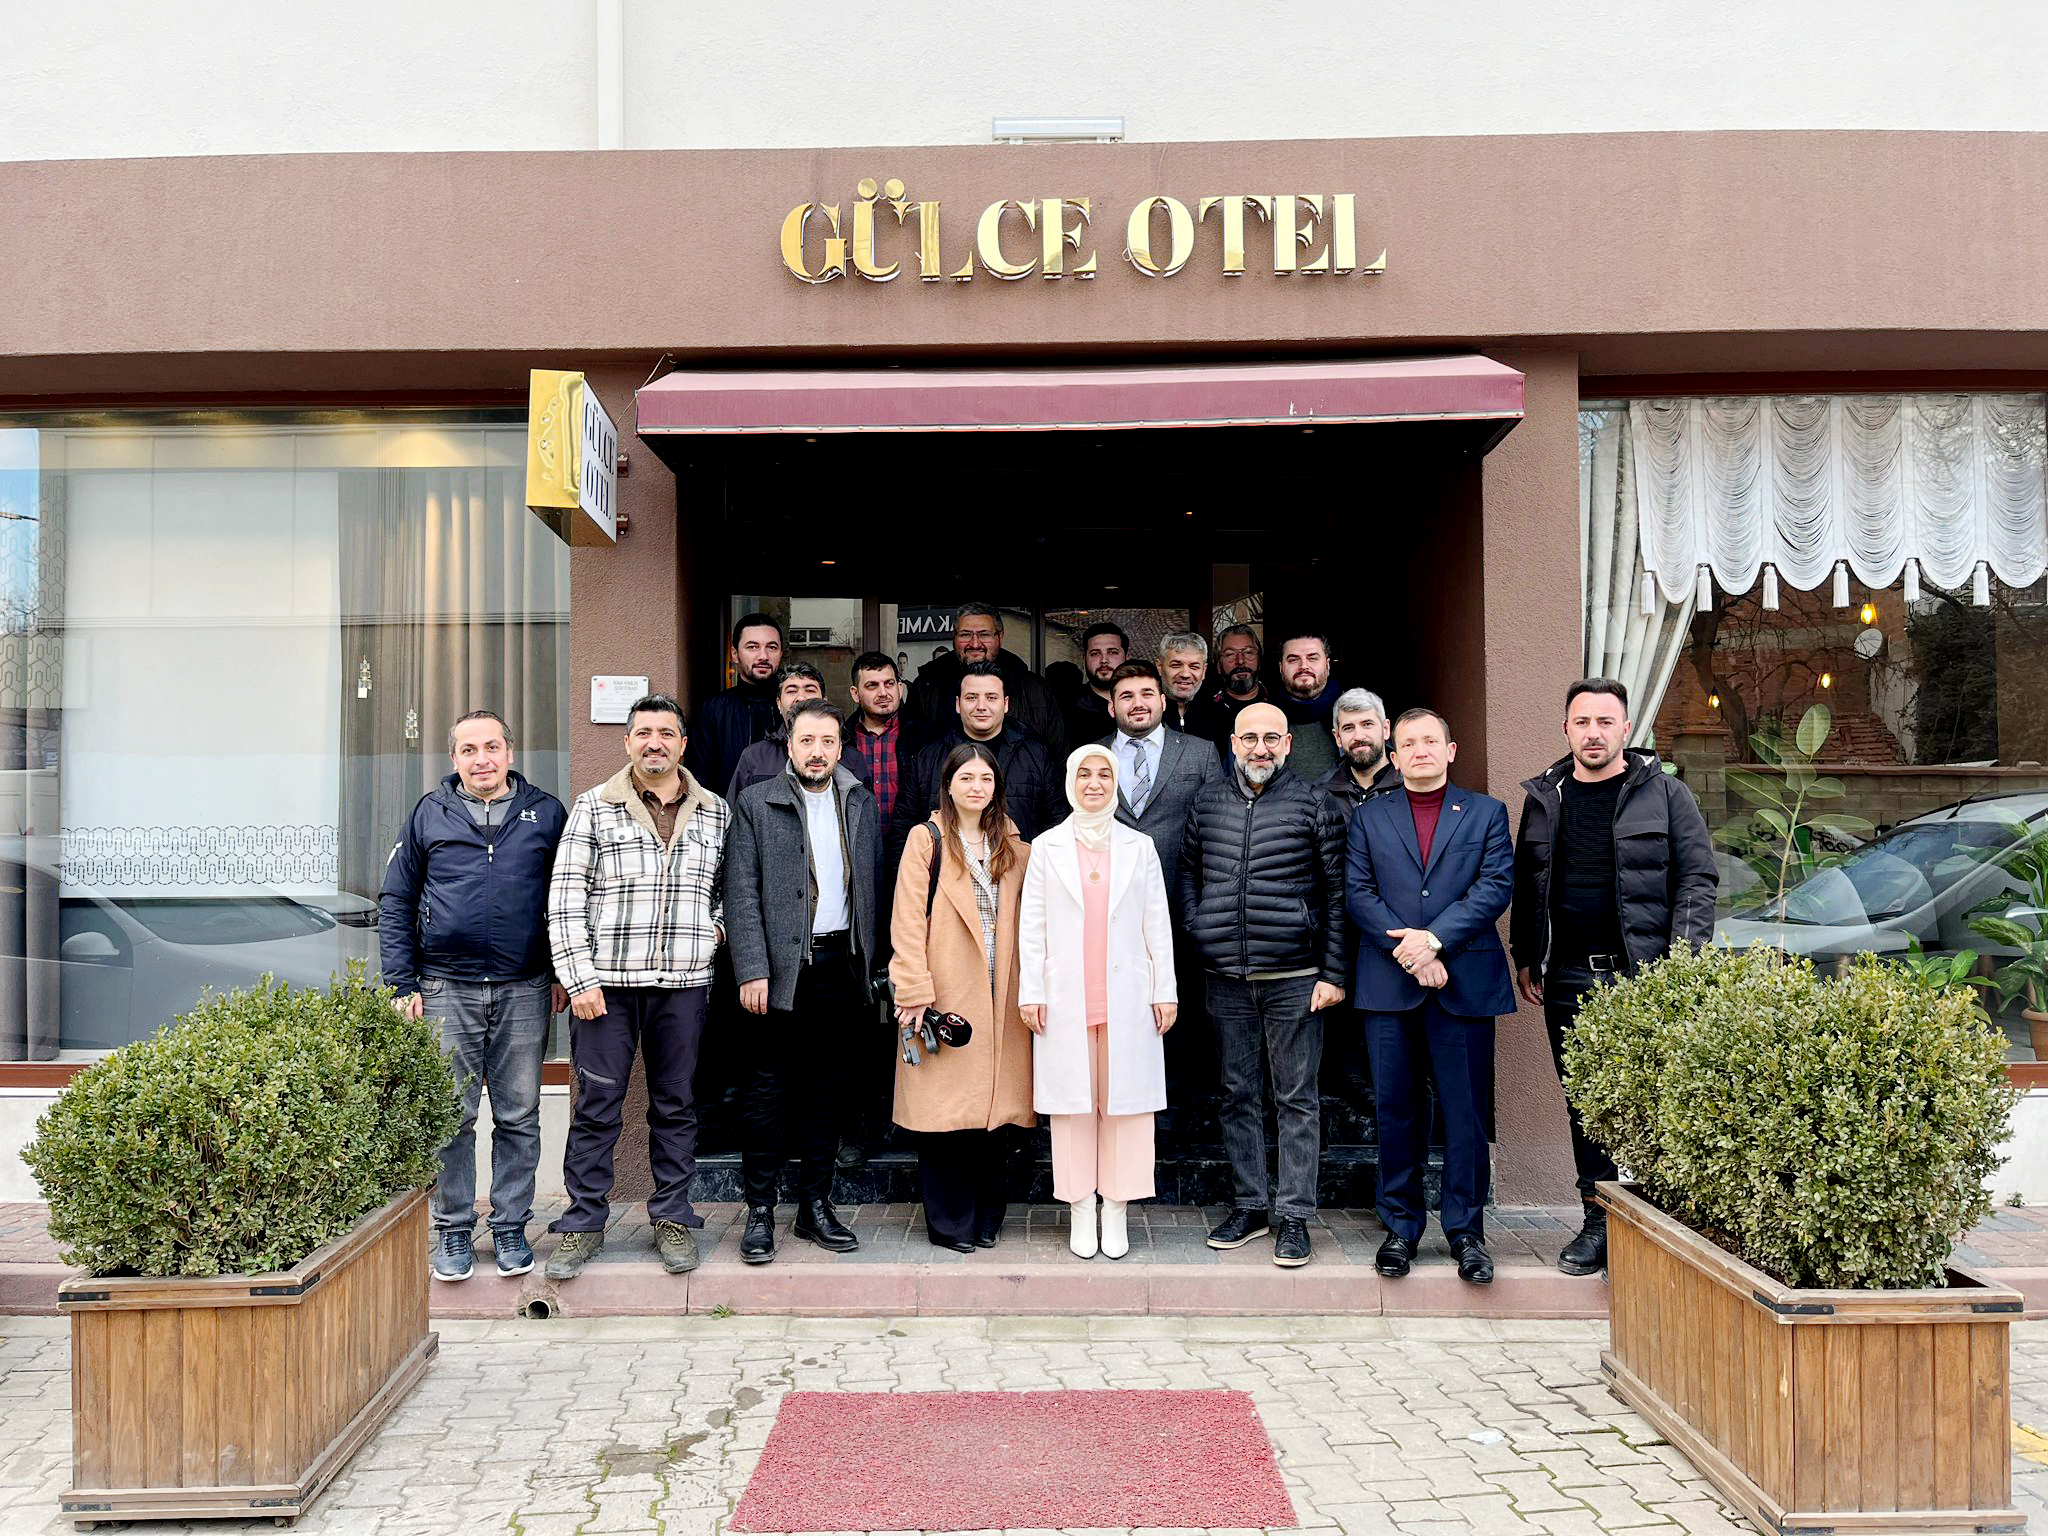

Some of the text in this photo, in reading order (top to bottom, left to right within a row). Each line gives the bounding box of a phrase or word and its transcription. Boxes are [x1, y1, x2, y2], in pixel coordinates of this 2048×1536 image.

[780, 178, 1387, 284] GÜLCE OTEL
[584, 402, 615, 476] GÜLCE
[585, 459, 612, 521] OTEL
